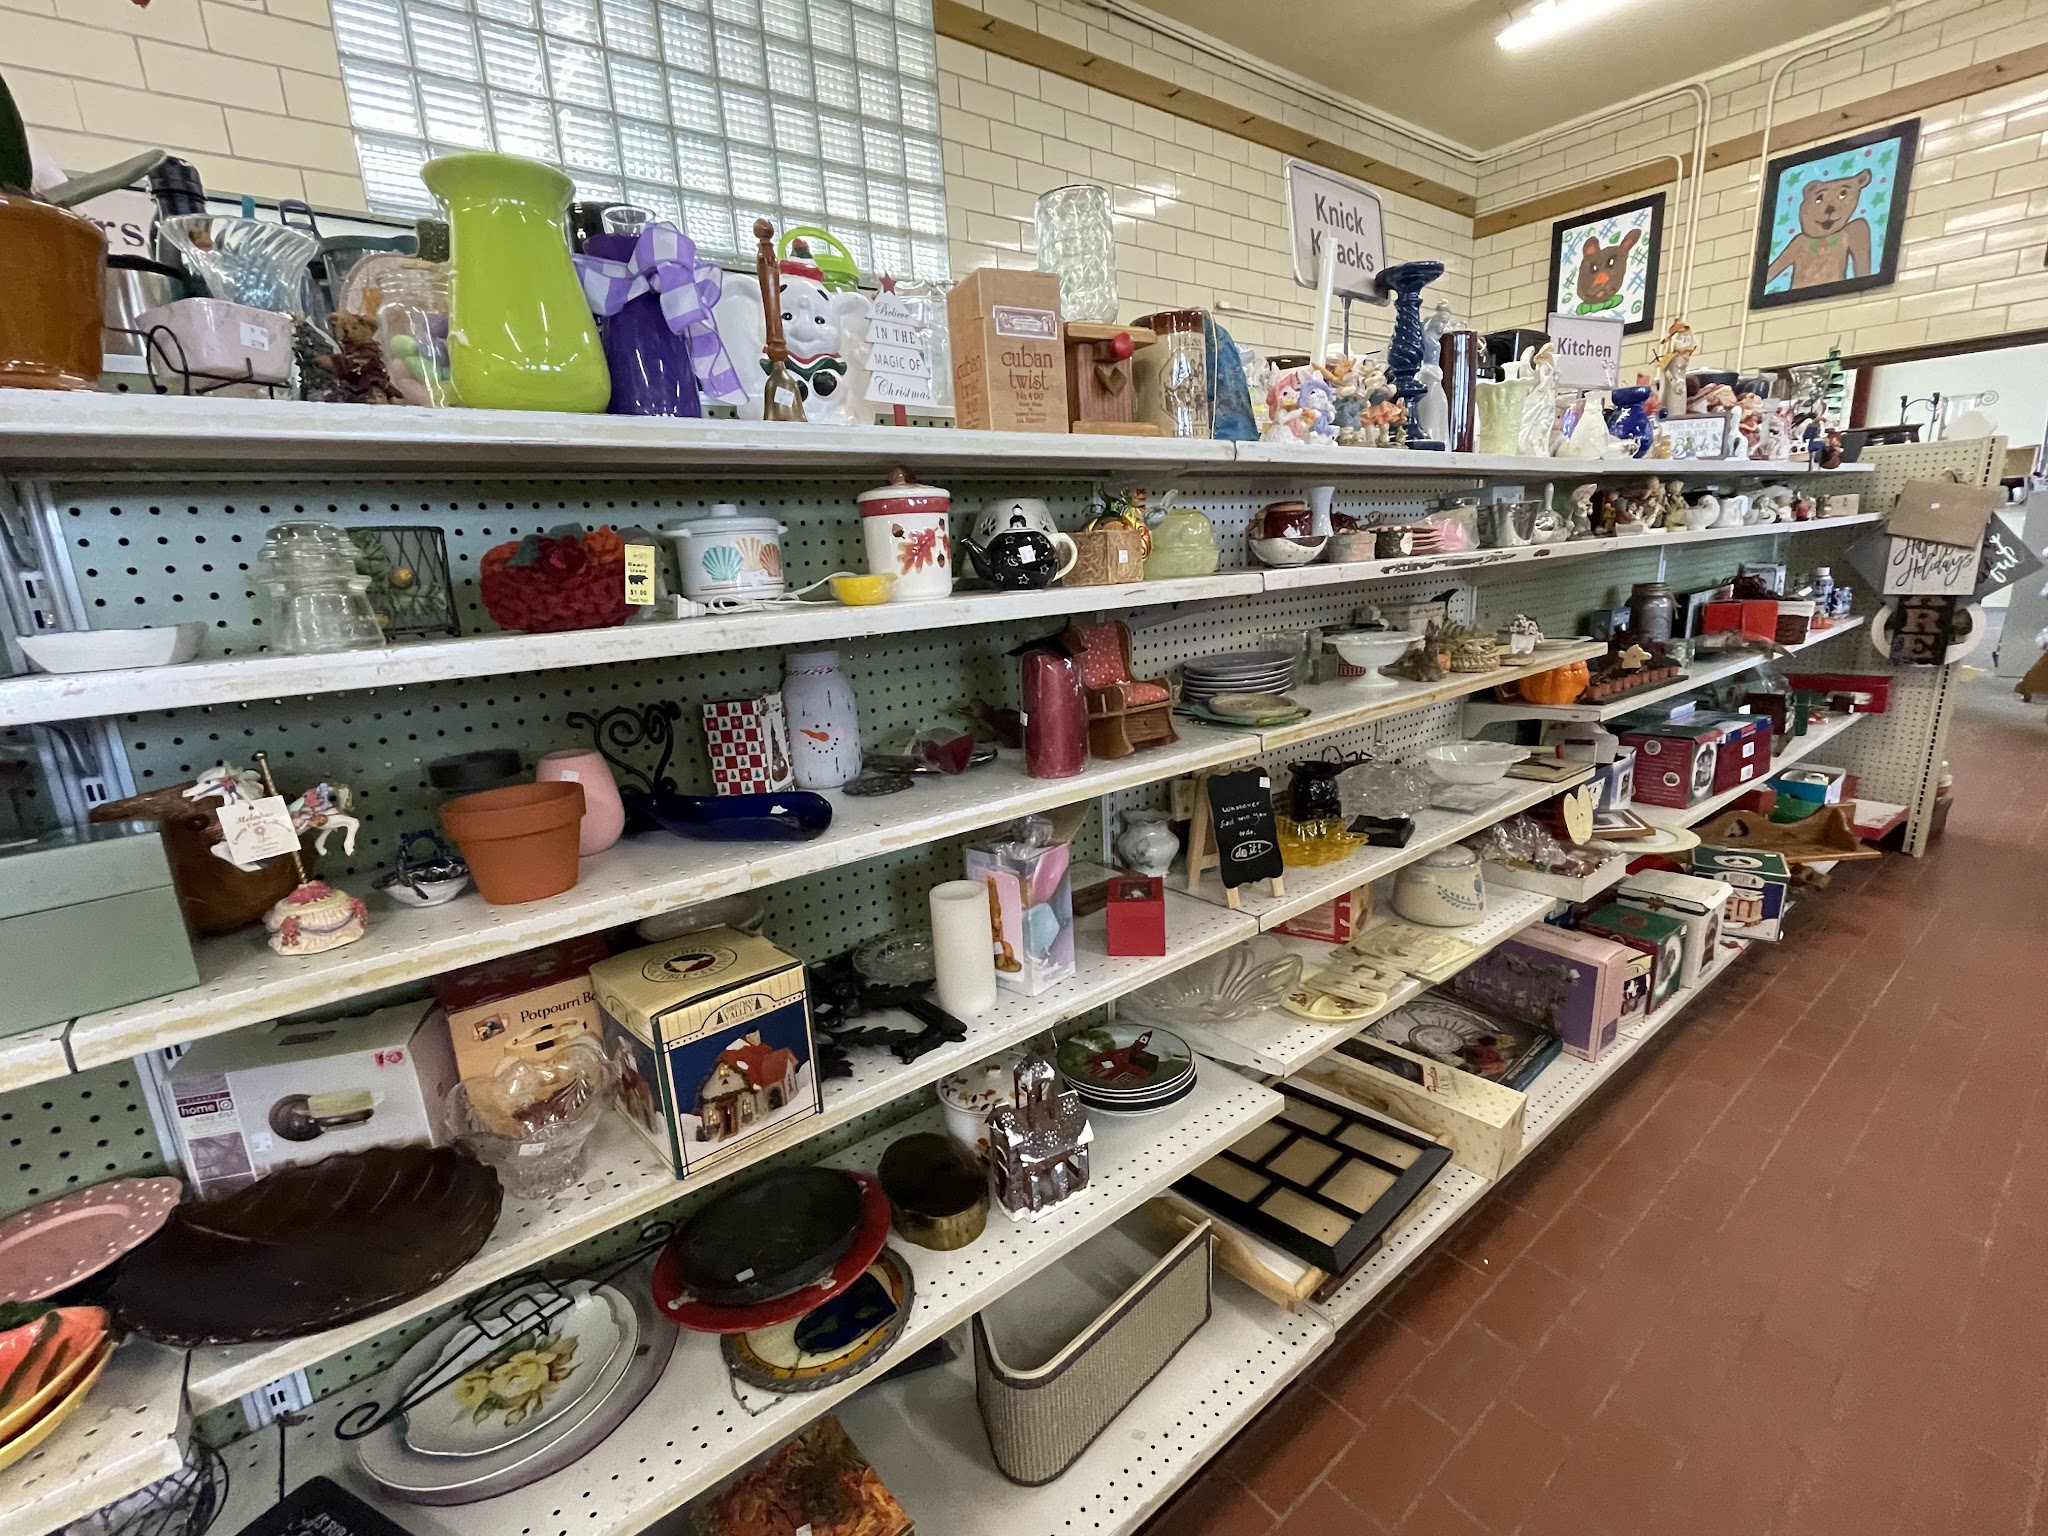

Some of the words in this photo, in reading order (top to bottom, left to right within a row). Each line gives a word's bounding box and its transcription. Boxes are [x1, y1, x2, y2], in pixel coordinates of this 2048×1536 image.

[1314, 193, 1365, 236] Knick
[1310, 228, 1375, 273] Kacks
[874, 301, 911, 320] Believe
[875, 325, 888, 340] IN
[892, 328, 916, 344] THE
[1001, 344, 1053, 369] cuban
[1557, 337, 1612, 358] Kitchen
[874, 353, 905, 370] MAGIC
[908, 358, 921, 371] OF
[873, 375, 931, 400] Christmas
[1008, 369, 1050, 391] twist
[1895, 553, 1975, 587] Holidays
[520, 995, 581, 1023] Potpourri
[722, 1004, 754, 1021] VALLEY
[180, 1103, 216, 1117] home
